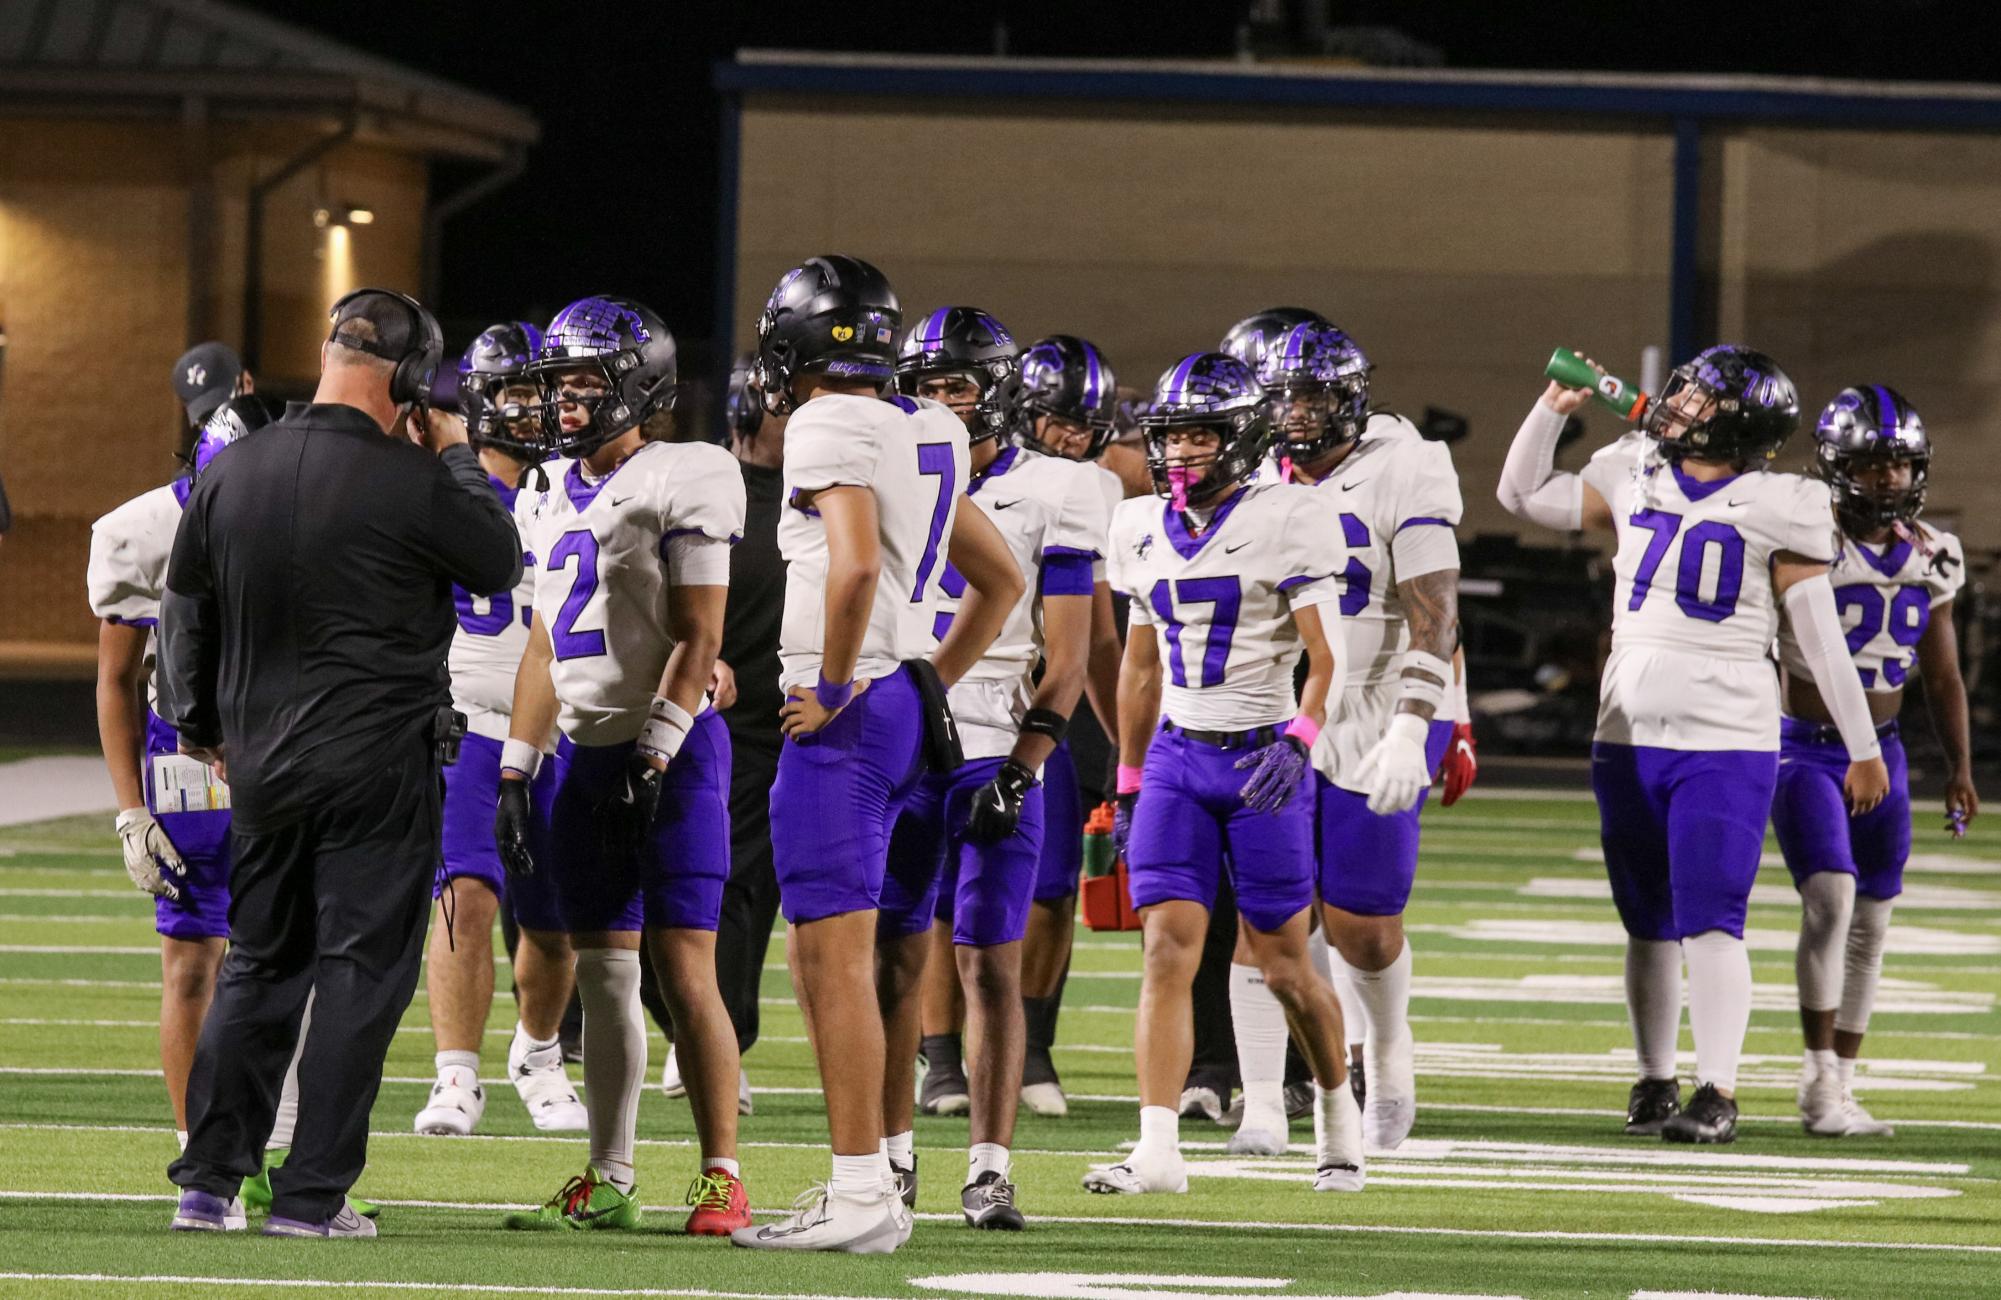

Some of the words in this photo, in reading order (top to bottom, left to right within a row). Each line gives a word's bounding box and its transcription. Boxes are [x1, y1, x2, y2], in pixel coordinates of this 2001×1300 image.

[1743, 368, 1778, 408] 70
[910, 442, 955, 603] 7
[1628, 507, 1746, 623] 70
[547, 529, 608, 662] 2
[1150, 574, 1242, 688] 17
[1833, 583, 1931, 689] 29
